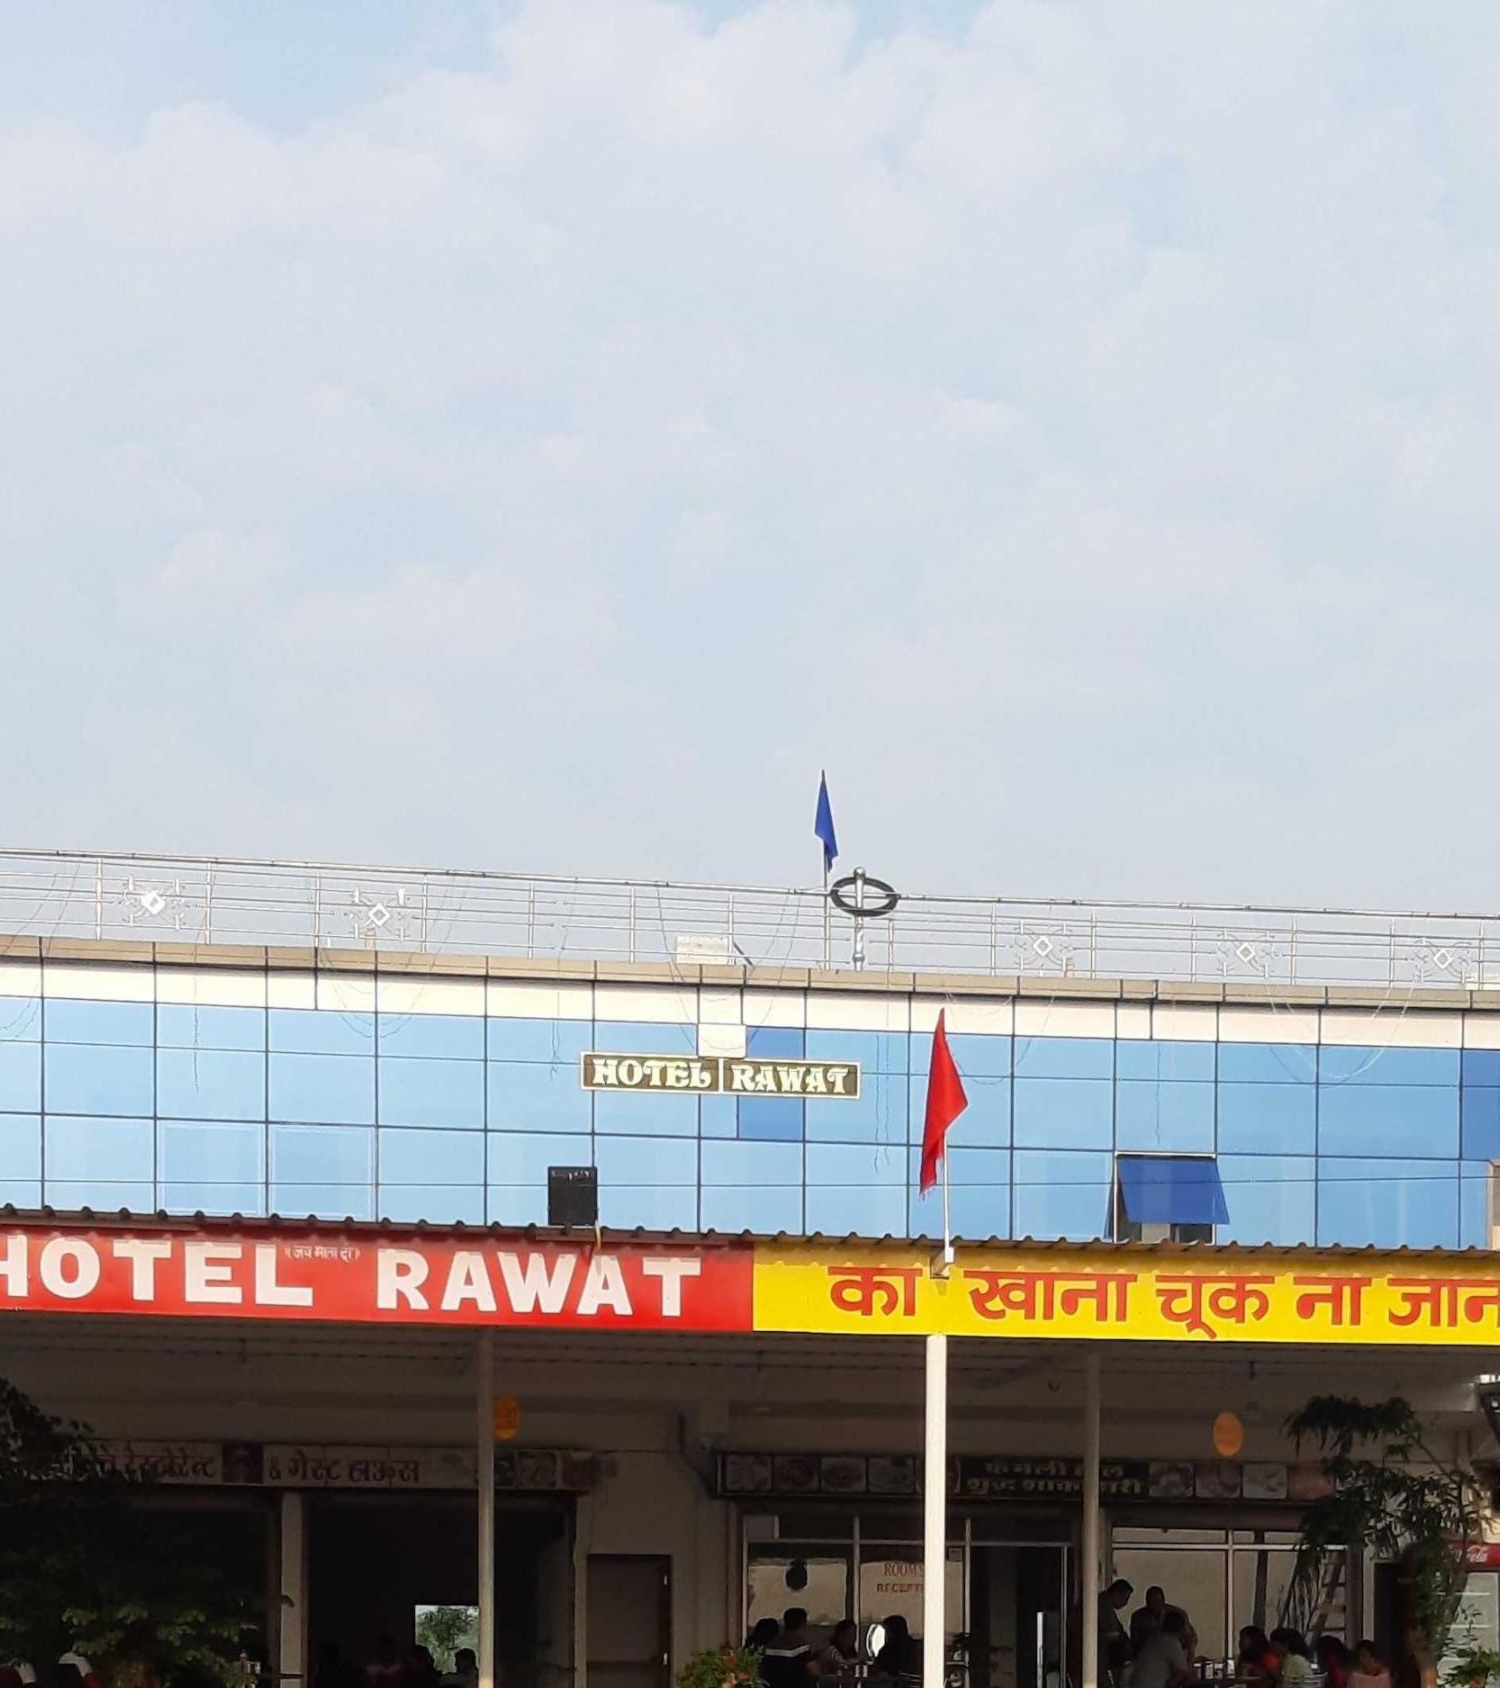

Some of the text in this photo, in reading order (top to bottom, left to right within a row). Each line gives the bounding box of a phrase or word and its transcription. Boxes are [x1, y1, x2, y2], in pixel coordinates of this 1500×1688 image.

[592, 1058, 850, 1095] HOTEL RAWAT
[375, 1247, 701, 1318] RAWAT
[827, 1266, 923, 1317] का
[963, 1268, 1138, 1323] खाना
[1155, 1273, 1275, 1340] चूक
[1295, 1276, 1371, 1327] ना
